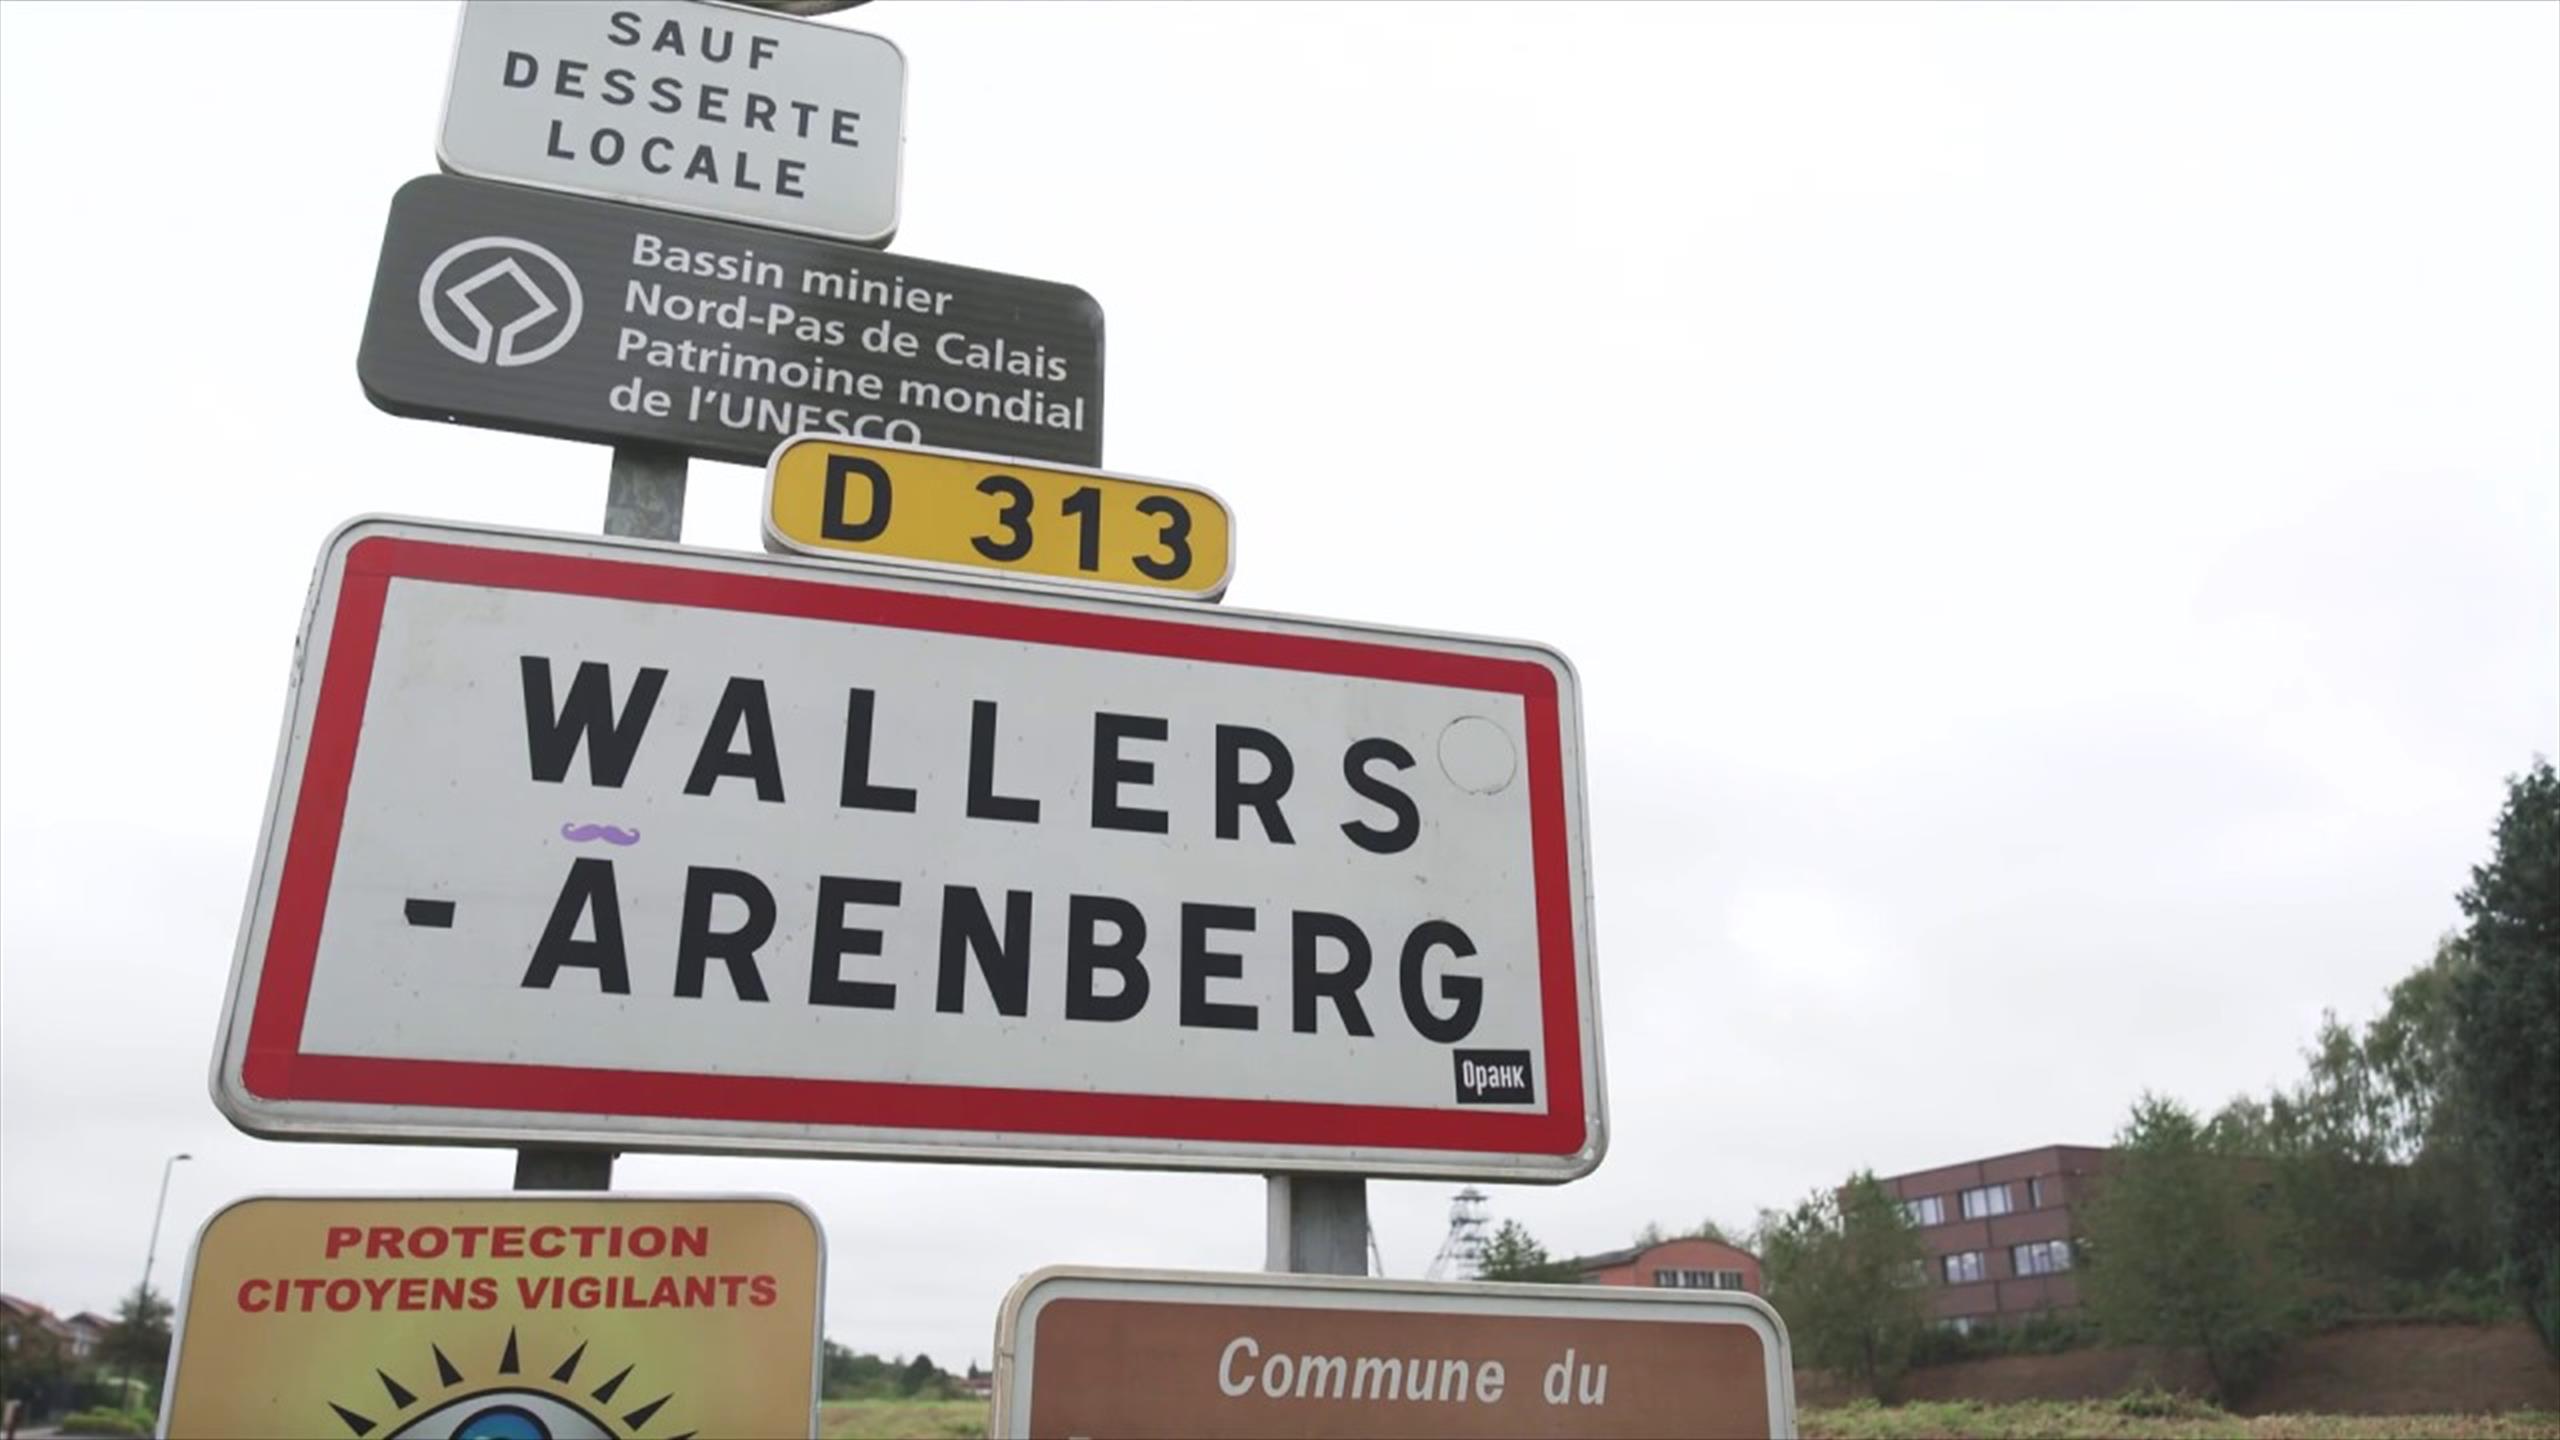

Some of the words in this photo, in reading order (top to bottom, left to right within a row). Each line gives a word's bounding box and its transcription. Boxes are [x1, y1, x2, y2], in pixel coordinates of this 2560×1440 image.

[607, 11, 779, 70] SAUF
[503, 50, 861, 148] DESSERTE
[547, 119, 807, 199] LOCALE
[632, 233, 784, 289] Bassin
[802, 266, 953, 315] minier
[625, 279, 845, 346] Nord-Pas
[861, 319, 919, 357] de
[935, 332, 1067, 381] Calais
[609, 376, 672, 417] de
[617, 327, 883, 400] Patrimoine
[899, 380, 1084, 431] mondial
[820, 453, 893, 543] D
[970, 474, 1193, 581] 313
[520, 655, 1421, 855] WALLERS
[520, 857, 1483, 1044] ARENBERG
[1462, 1060, 1525, 1096] Оранк
[325, 1225, 709, 1259] PROTECTION
[238, 1277, 498, 1313] CITOYENS
[518, 1274, 777, 1310] VIGILANTS
[1219, 1337, 1505, 1403] Commune
[1544, 1349, 1607, 1404] du
